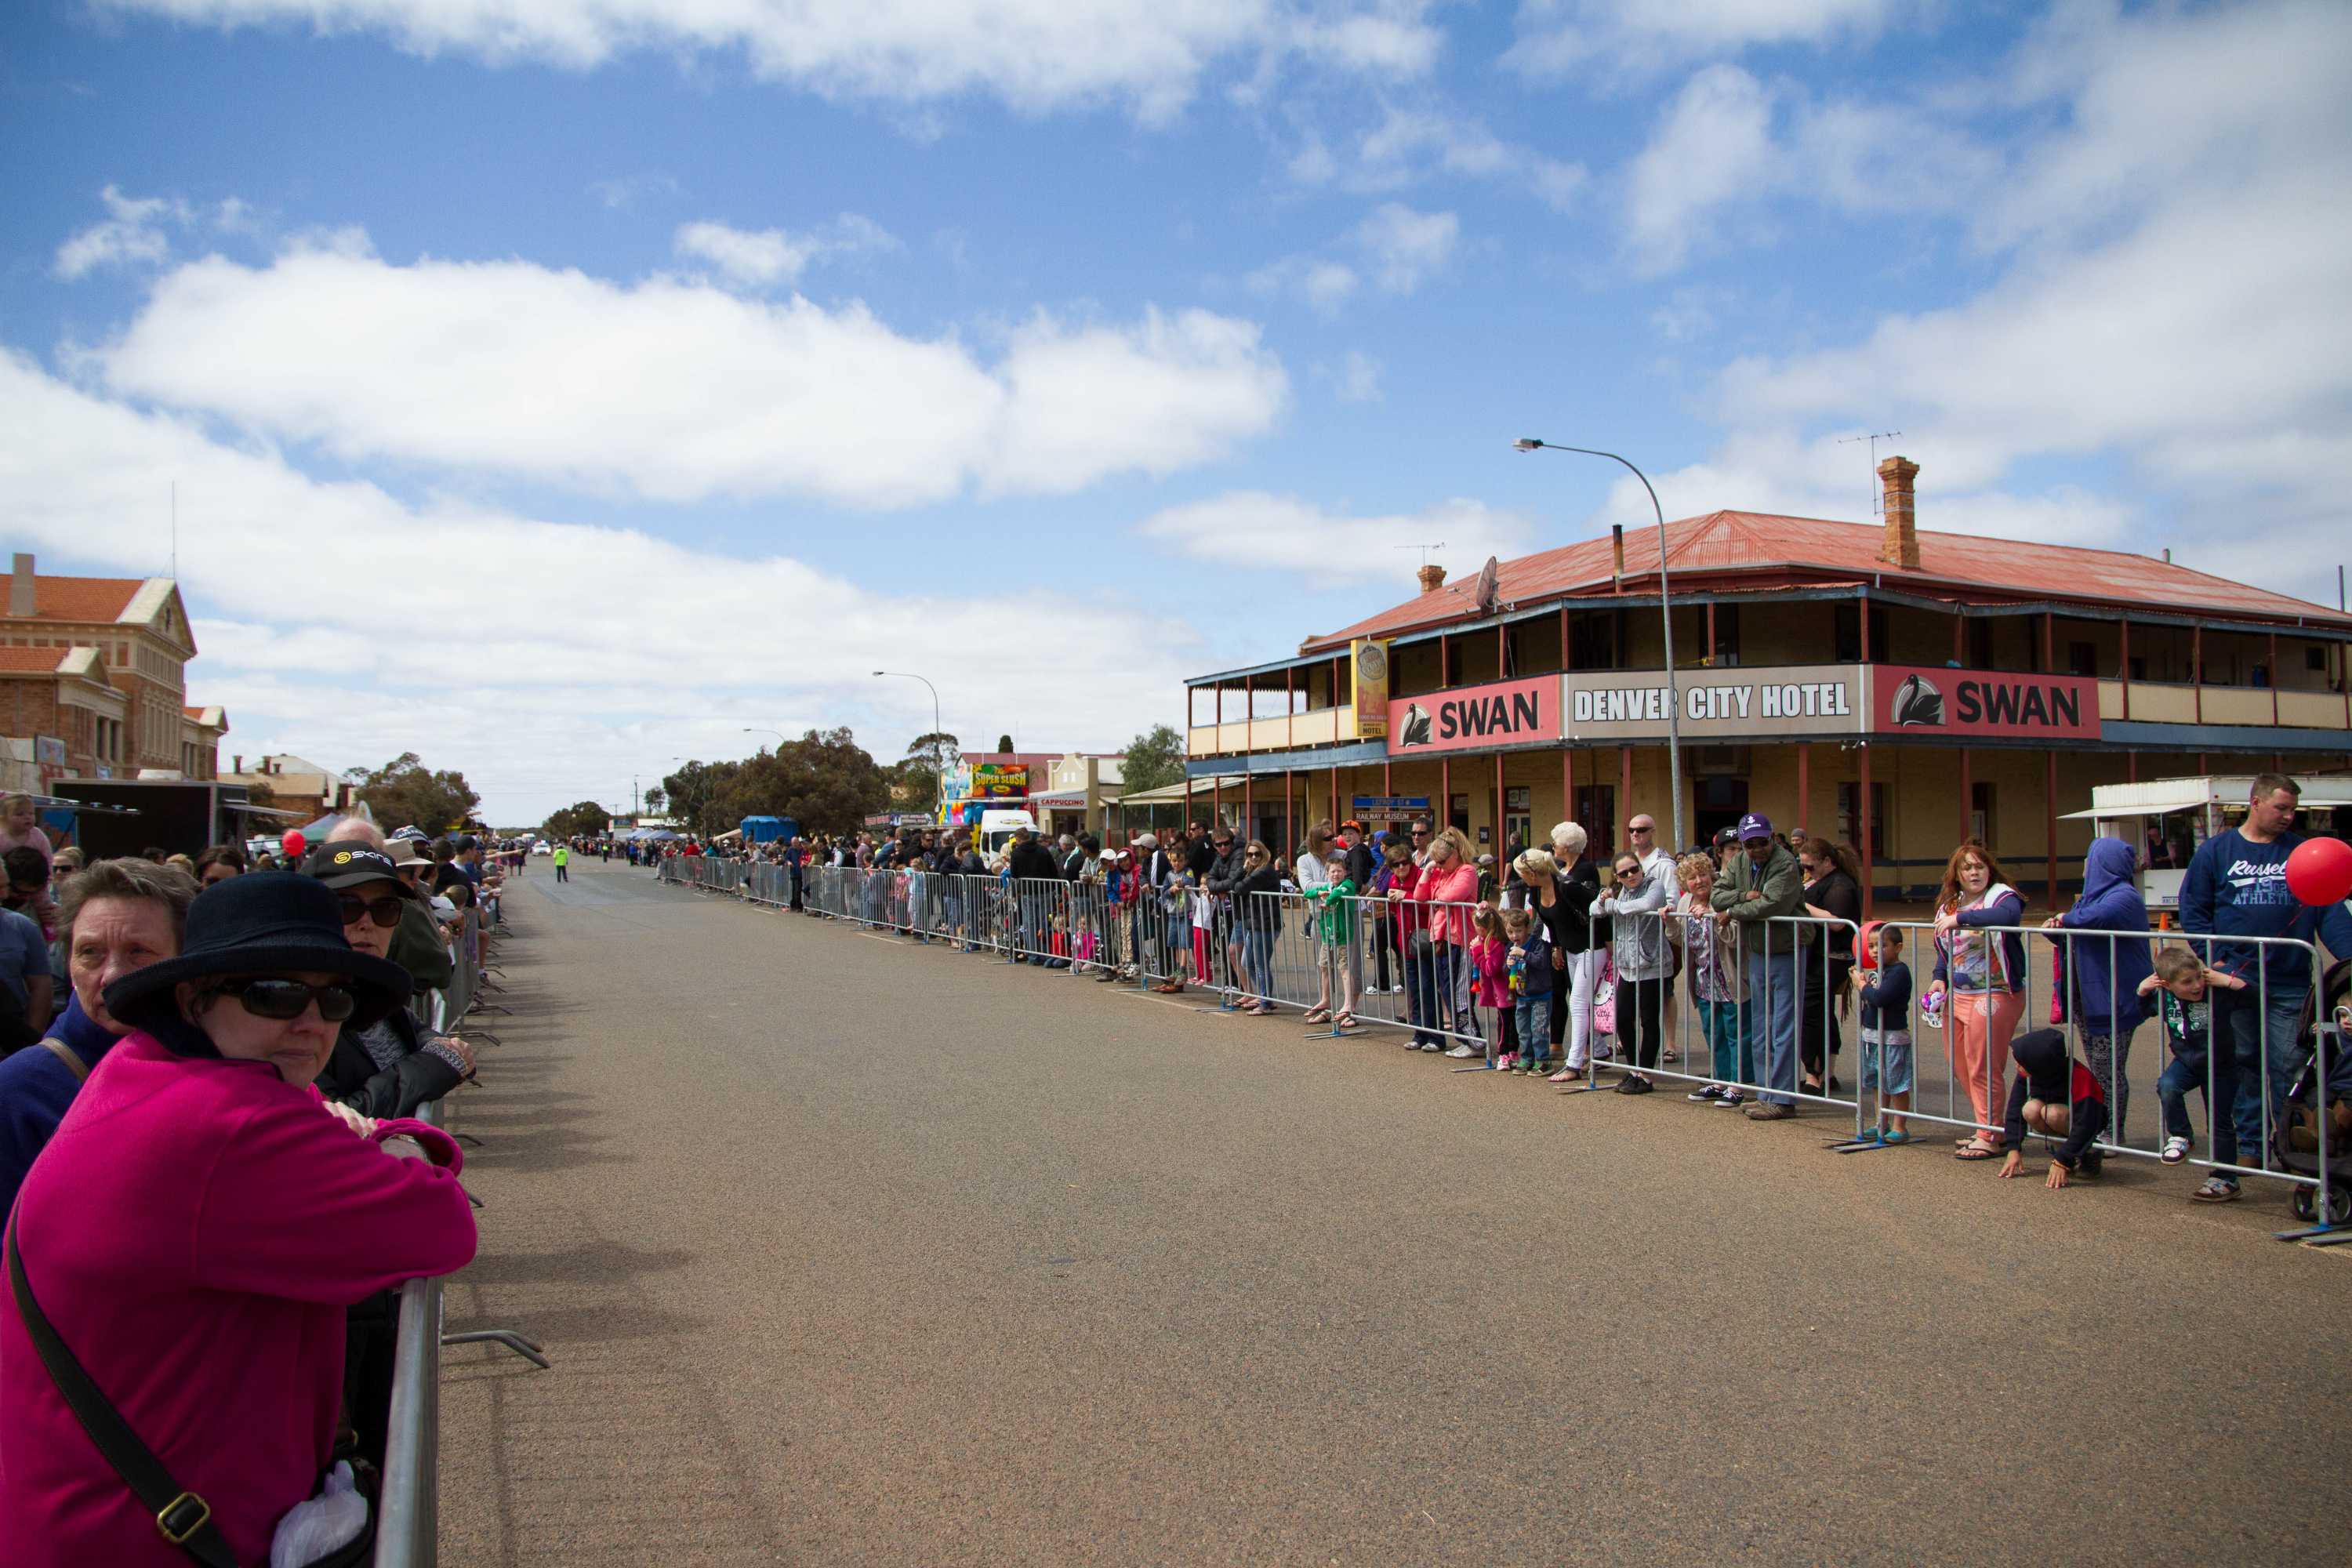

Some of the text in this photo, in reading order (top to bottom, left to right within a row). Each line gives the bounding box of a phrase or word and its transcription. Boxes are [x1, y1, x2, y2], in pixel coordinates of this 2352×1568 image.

[1440, 690, 1539, 739] SWAN
[1574, 682, 1850, 722] DENVER CITY HOTEL
[1956, 681, 2081, 728] SWAN
[975, 771, 1026, 786] SUPER SLUSH
[1041, 798, 1085, 807] CAPPUCCINO
[2227, 859, 2288, 877] Russel
